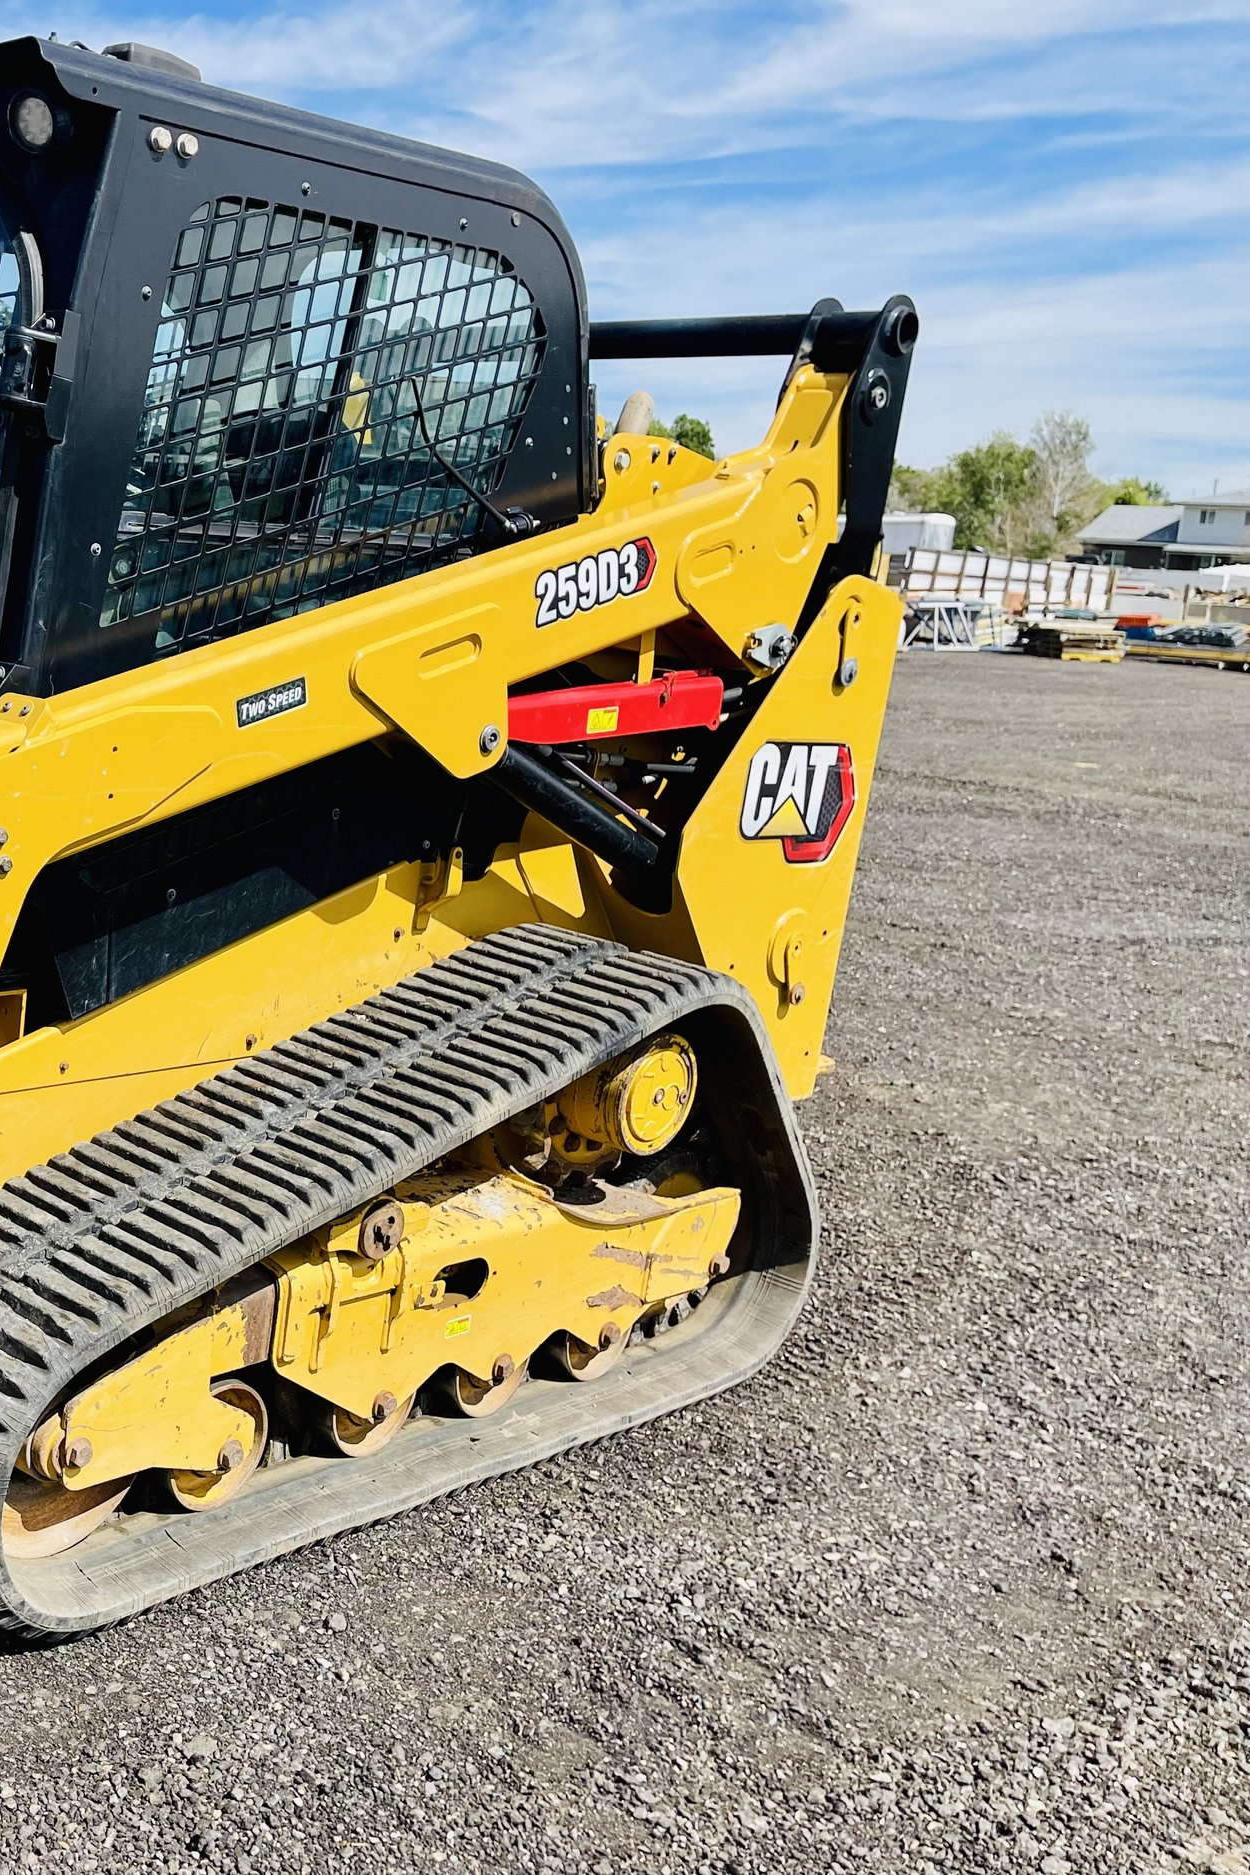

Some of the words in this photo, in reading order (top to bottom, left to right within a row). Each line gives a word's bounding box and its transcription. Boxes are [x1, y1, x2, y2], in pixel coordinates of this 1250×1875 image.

[536, 543, 639, 626] 259D3
[241, 699, 266, 720] TWO
[268, 686, 302, 711] SPEED
[741, 743, 839, 837] CAT
